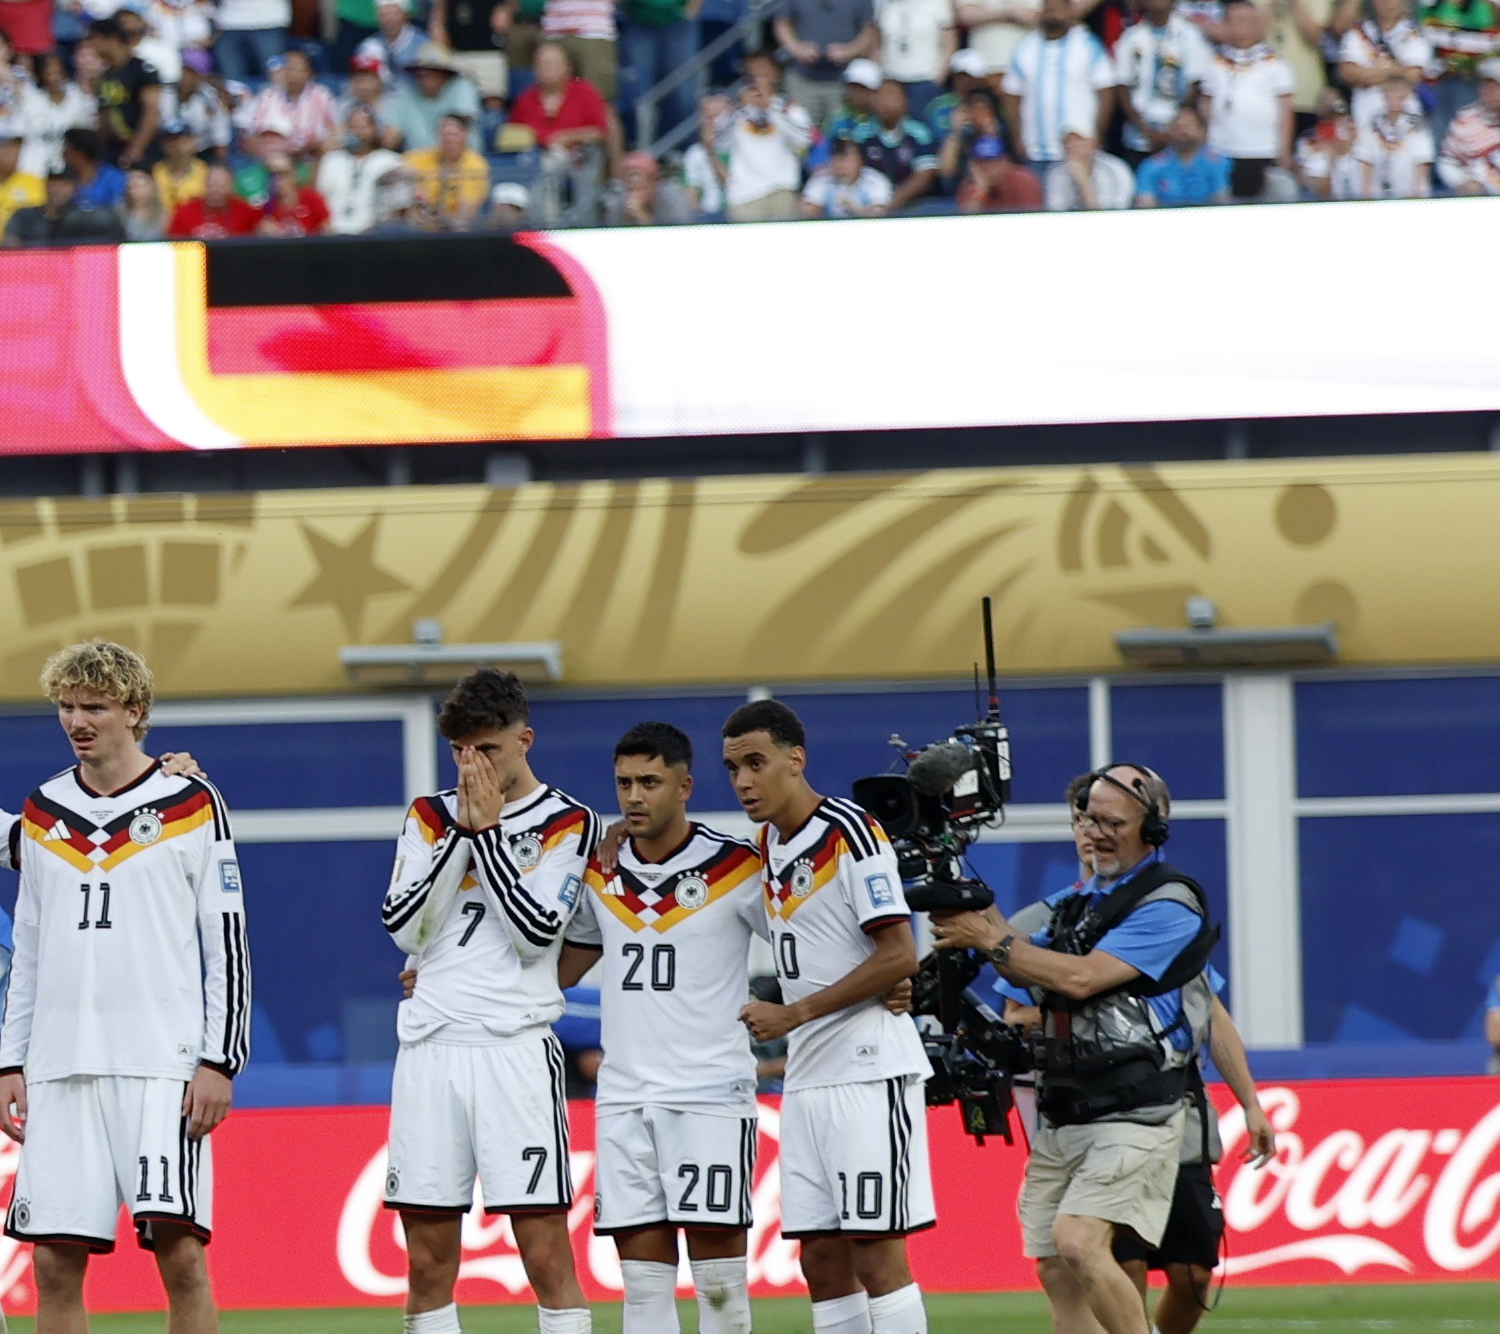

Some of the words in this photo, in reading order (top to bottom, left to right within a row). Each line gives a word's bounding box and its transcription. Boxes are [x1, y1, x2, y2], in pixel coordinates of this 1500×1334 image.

[78, 882, 113, 931] 11
[459, 900, 487, 948] 7
[621, 943, 676, 992] 20
[771, 930, 800, 980] 0
[137, 1156, 174, 1204] 11
[522, 1147, 548, 1195] 7
[677, 1163, 732, 1213] 20
[839, 1171, 882, 1221] 10
